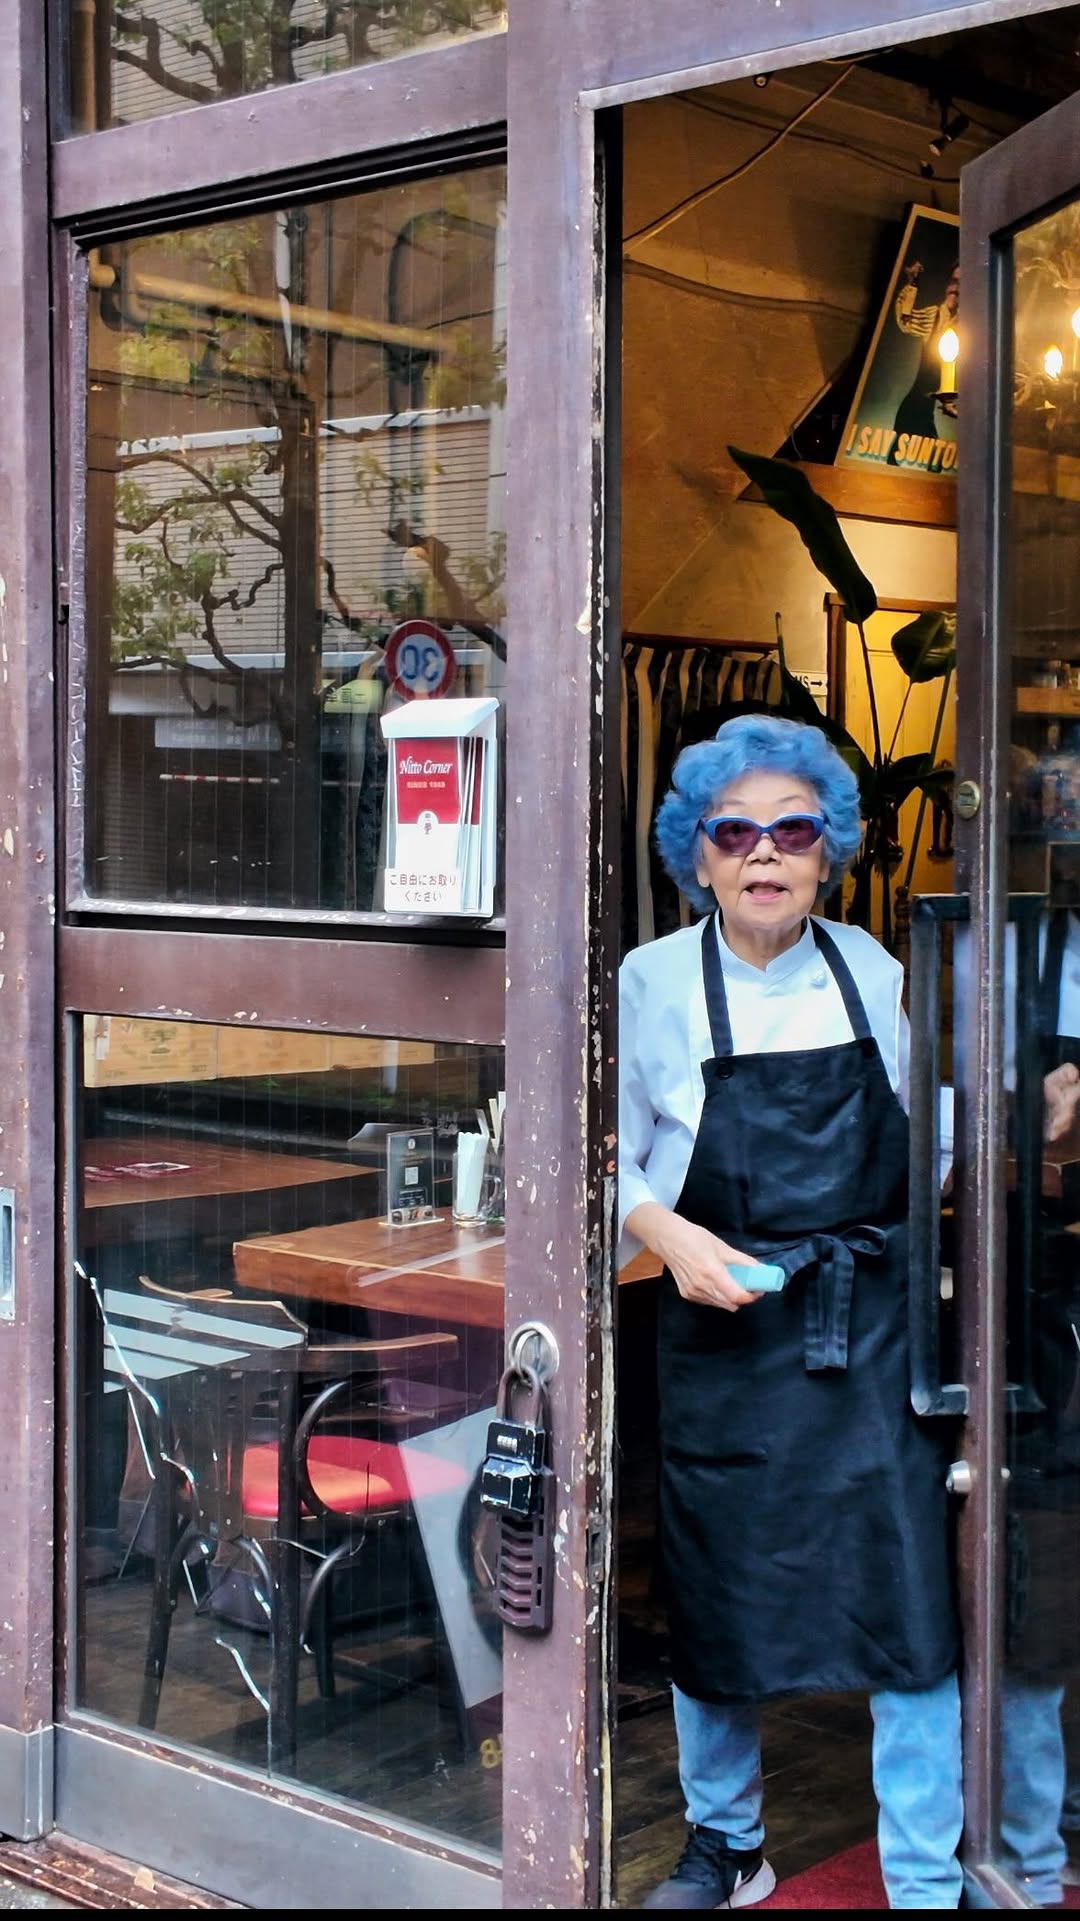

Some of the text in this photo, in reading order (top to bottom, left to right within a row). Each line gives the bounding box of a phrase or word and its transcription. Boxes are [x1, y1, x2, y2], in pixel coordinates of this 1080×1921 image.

[845, 424, 958, 472] I SAY SUNTO
[399, 755, 453, 775] Nitto Corner
